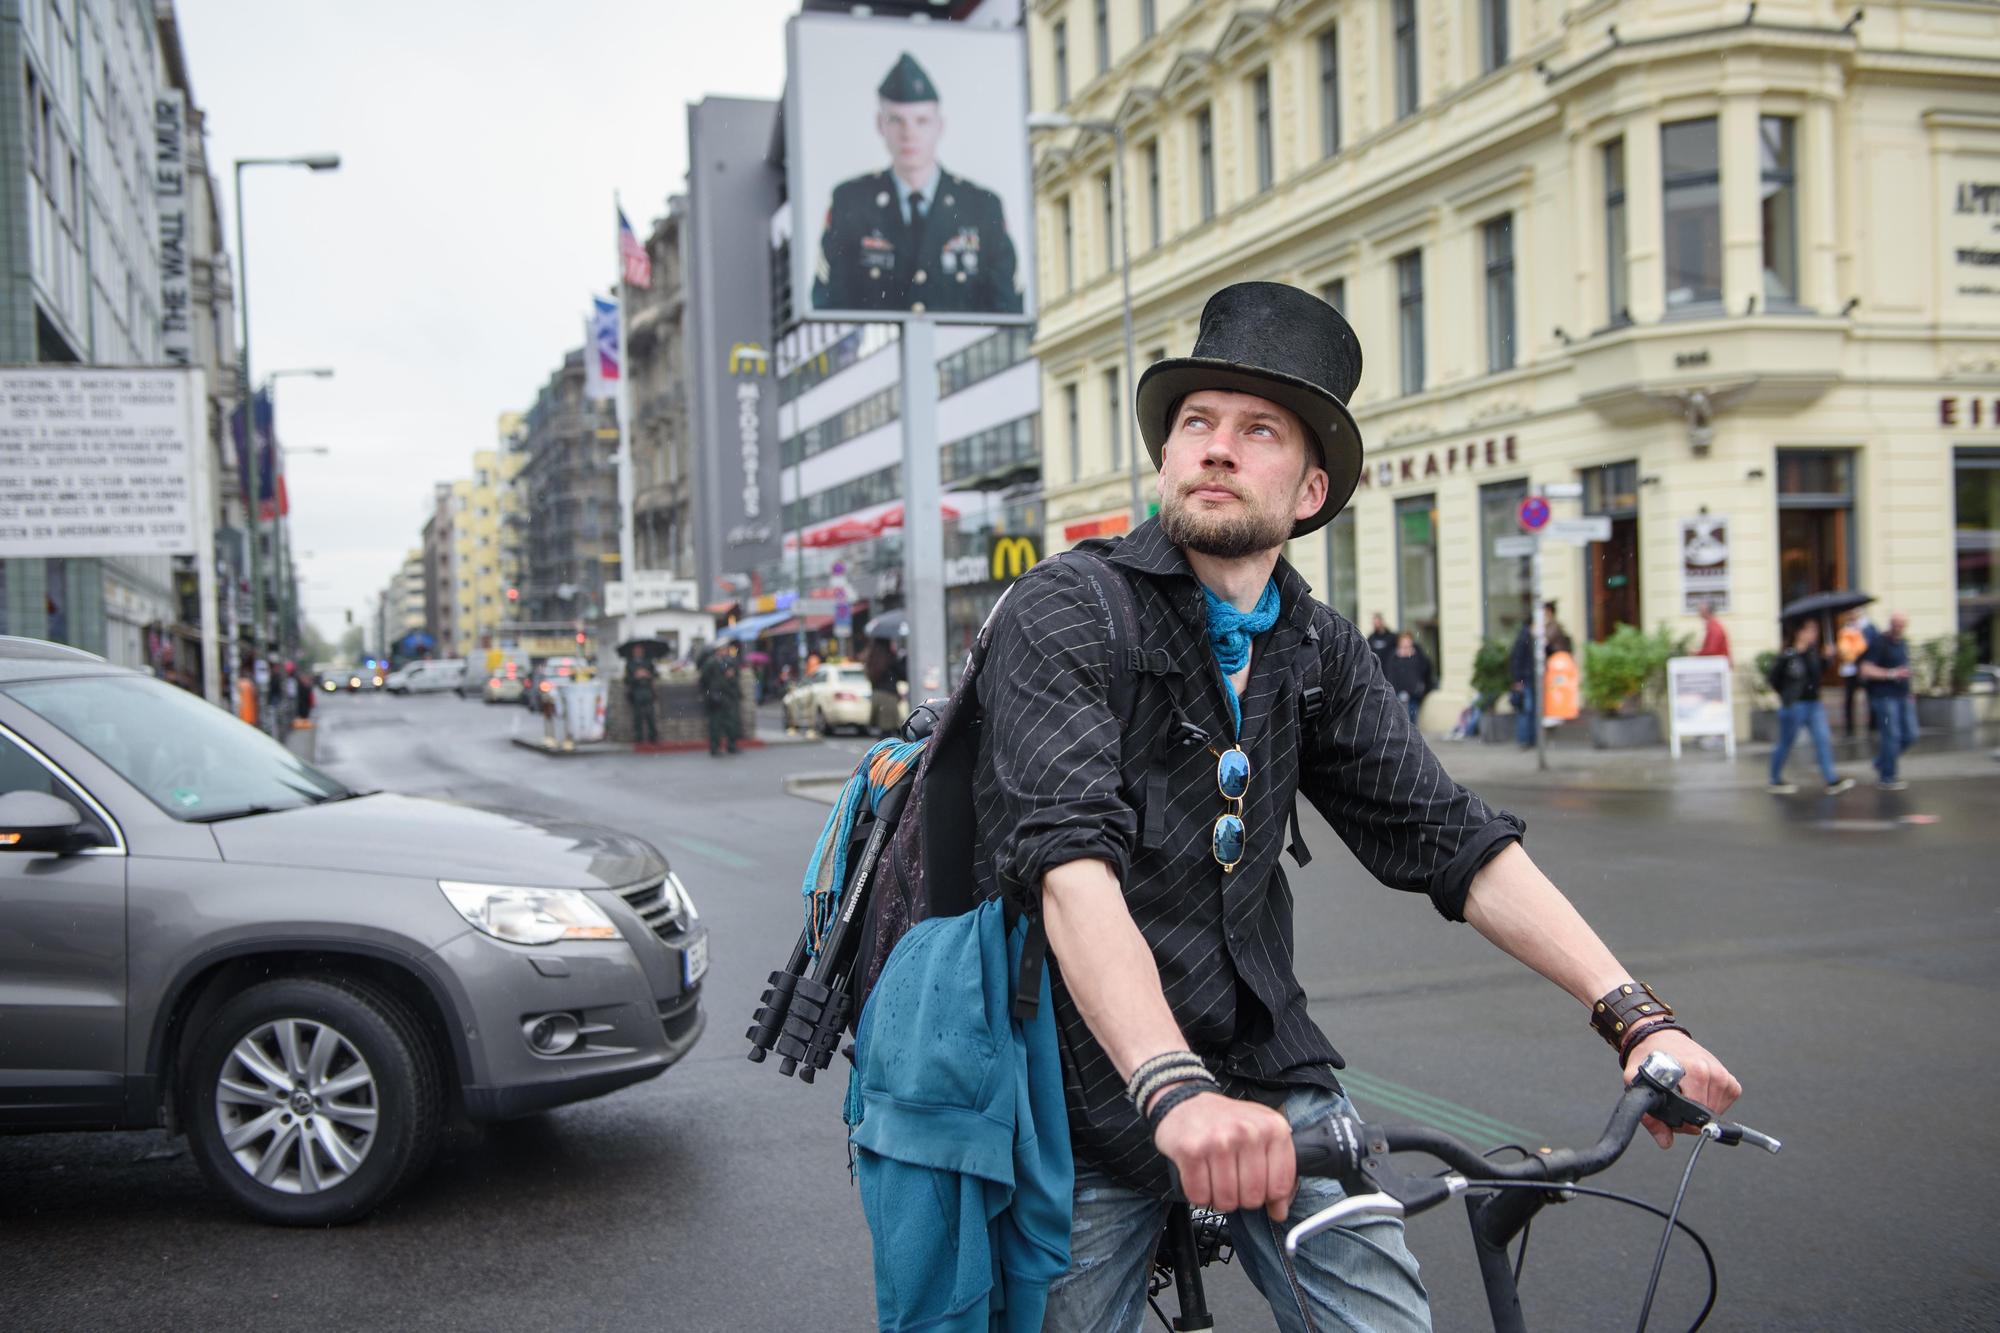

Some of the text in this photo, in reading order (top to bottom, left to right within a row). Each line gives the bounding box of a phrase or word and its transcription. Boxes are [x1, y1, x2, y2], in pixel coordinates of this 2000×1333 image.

[155, 99, 182, 163] MUR
[157, 170, 183, 196] LE
[160, 213, 185, 280] WALL
[163, 287, 187, 333] THE
[1400, 435, 1517, 480] KAFFEE
[1087, 574, 1117, 641] SALOMON
[842, 871, 868, 923] Manfrotto
